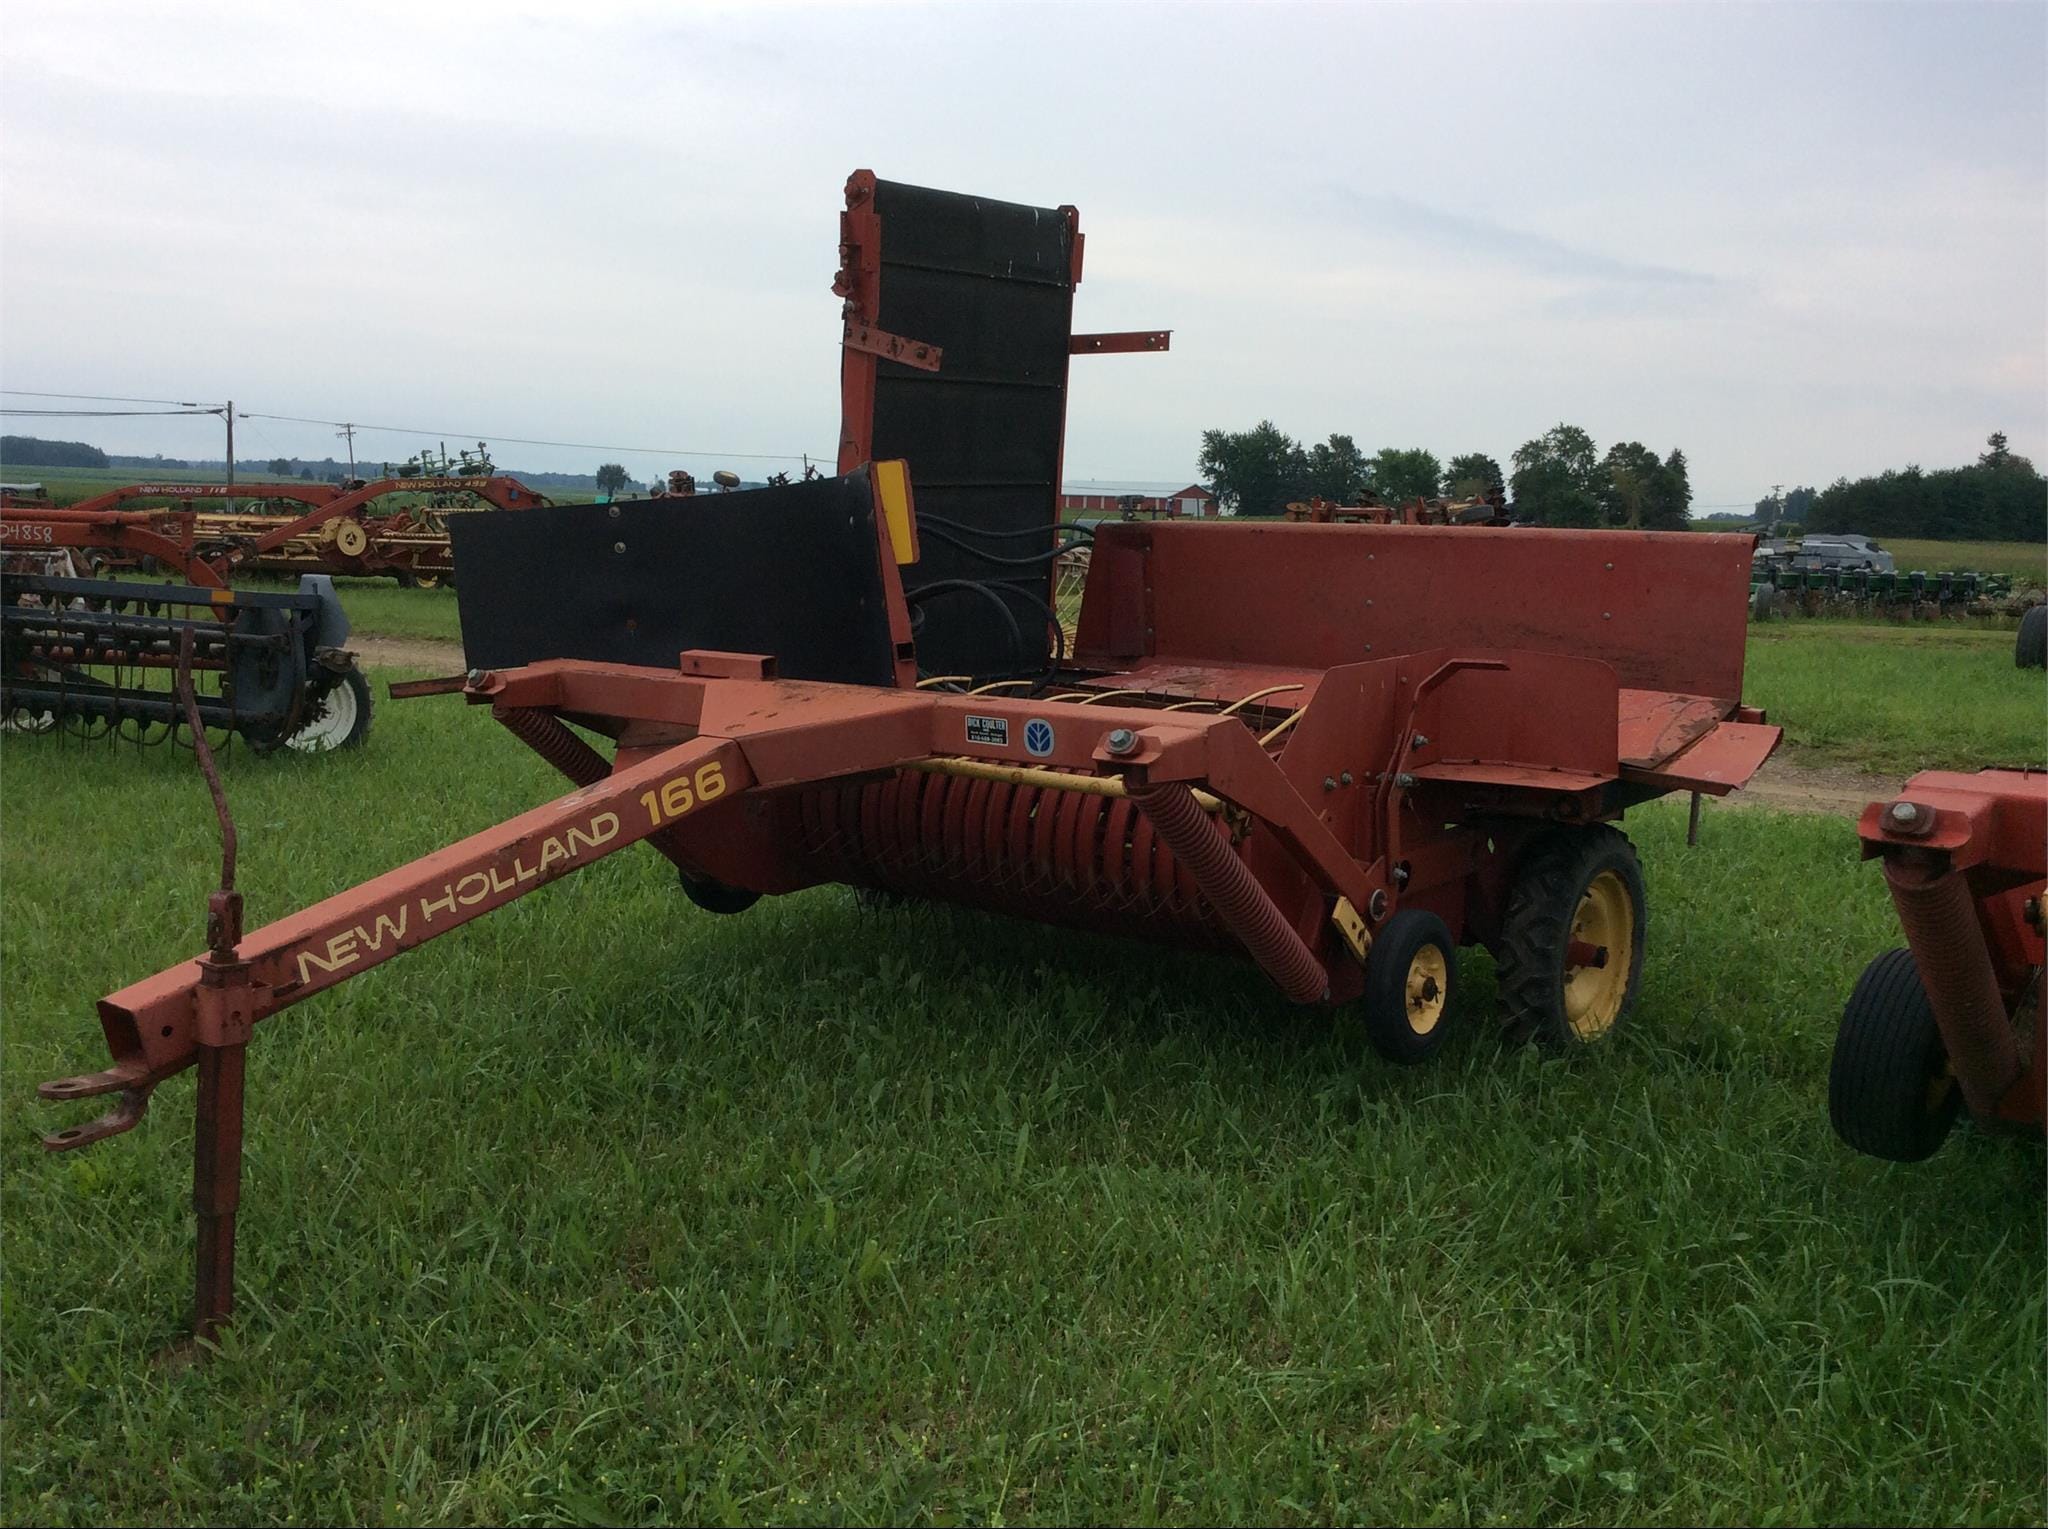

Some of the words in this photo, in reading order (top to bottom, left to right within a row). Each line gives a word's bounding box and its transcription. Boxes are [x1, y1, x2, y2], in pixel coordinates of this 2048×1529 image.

[419, 481, 461, 489] HOLLAND
[140, 486, 160, 494] NEW
[161, 486, 202, 494] HOLLAND
[297, 903, 409, 984] NEW
[420, 811, 620, 922] HOLLAND
[639, 761, 727, 826] 166
